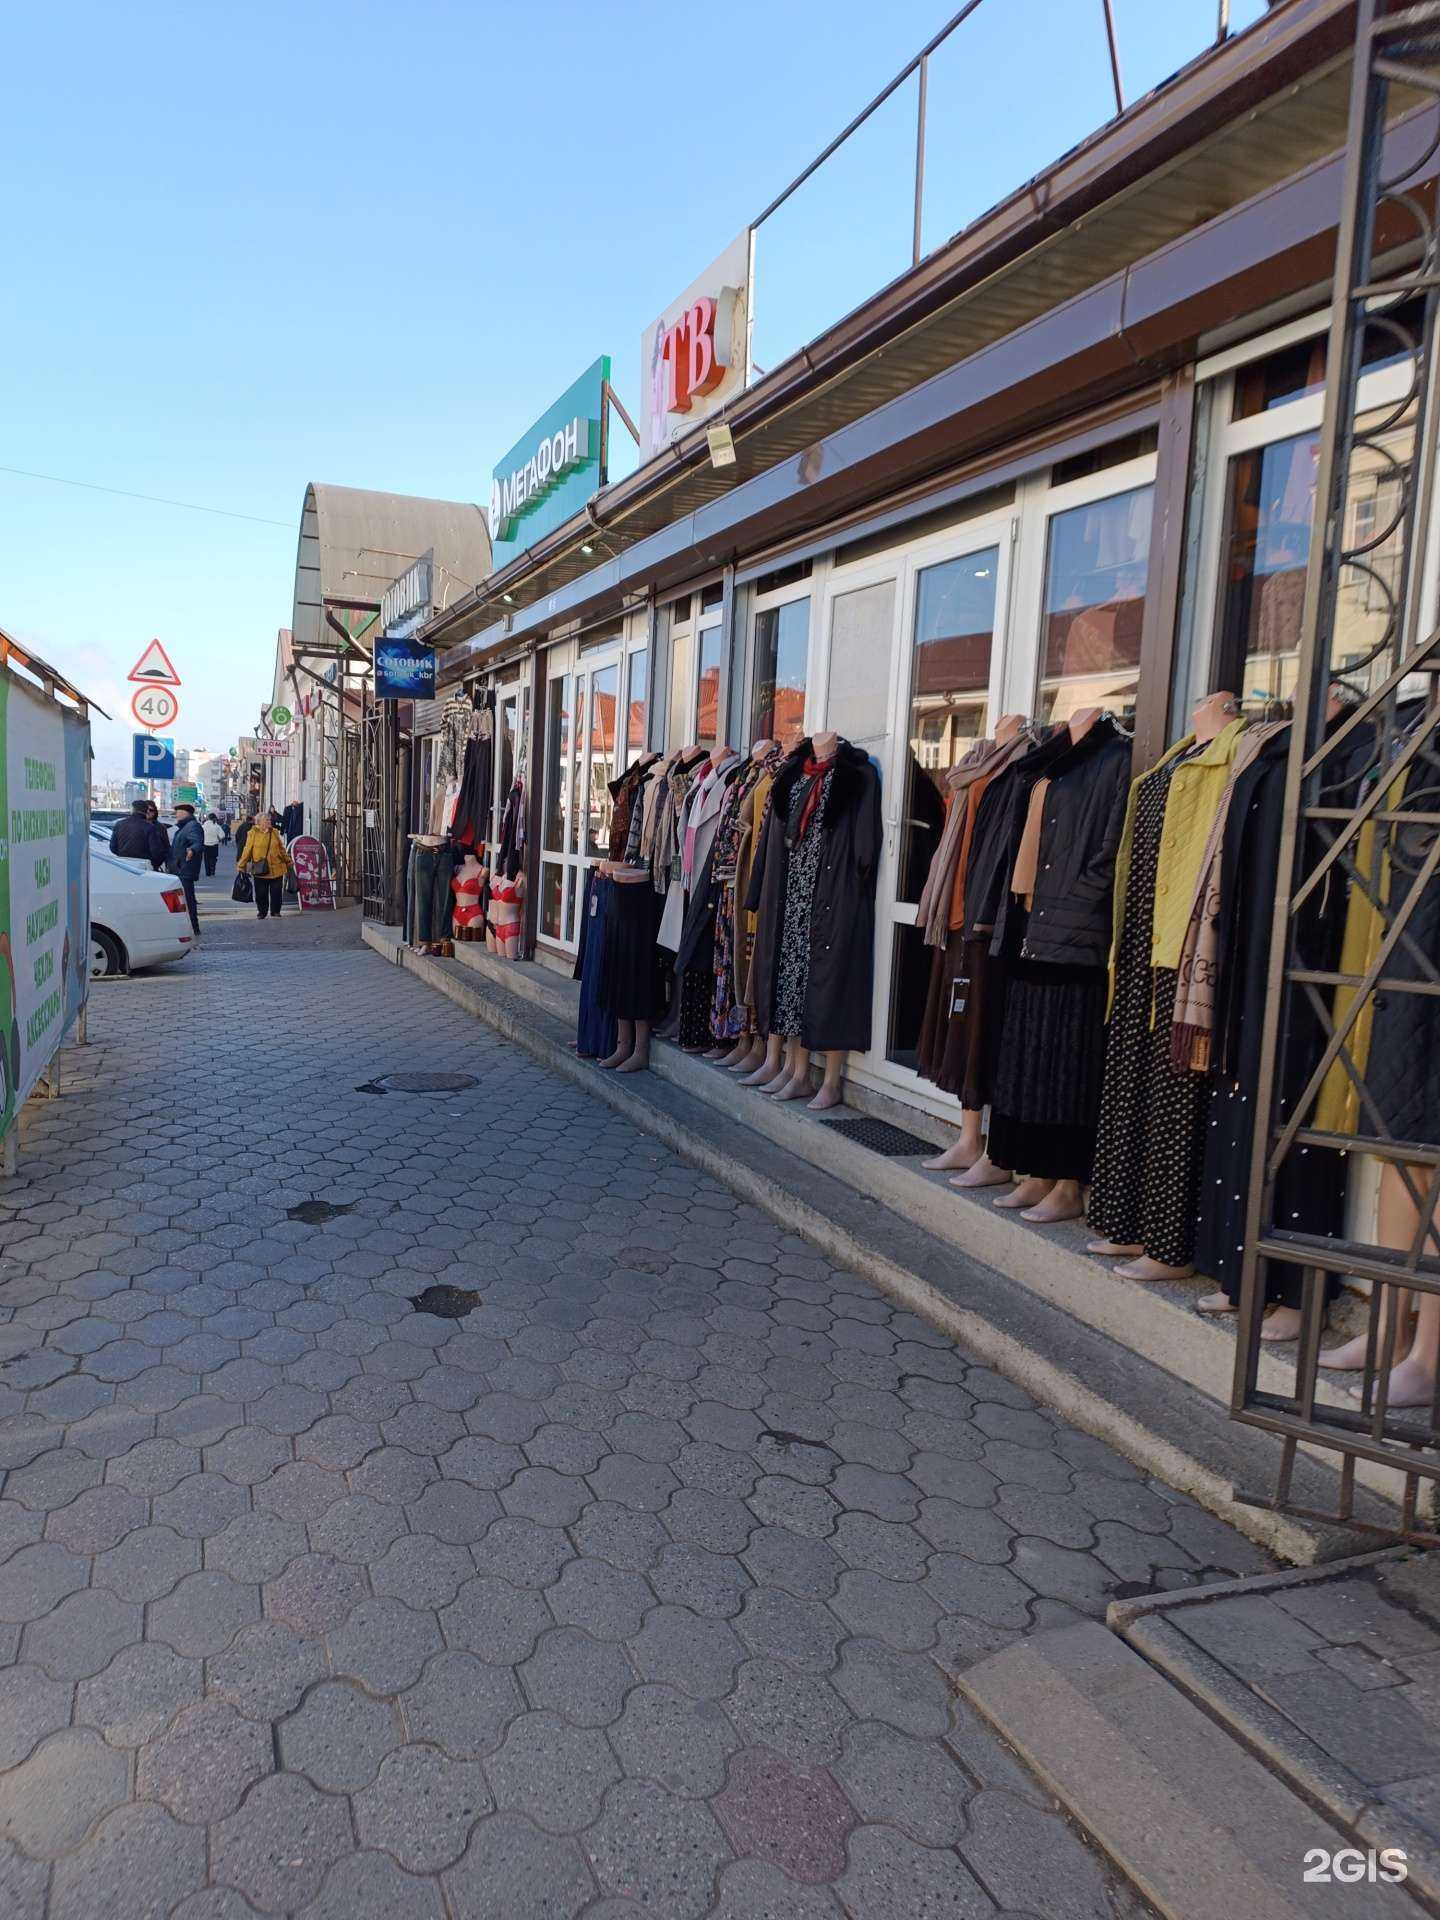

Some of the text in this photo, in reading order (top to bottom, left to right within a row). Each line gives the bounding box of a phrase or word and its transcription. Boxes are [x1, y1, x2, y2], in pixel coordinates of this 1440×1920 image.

[503, 416, 579, 517] МЕГАФОН
[140, 697, 169, 716] 40
[143, 740, 166, 774] P
[11, 810, 21, 844] ПО
